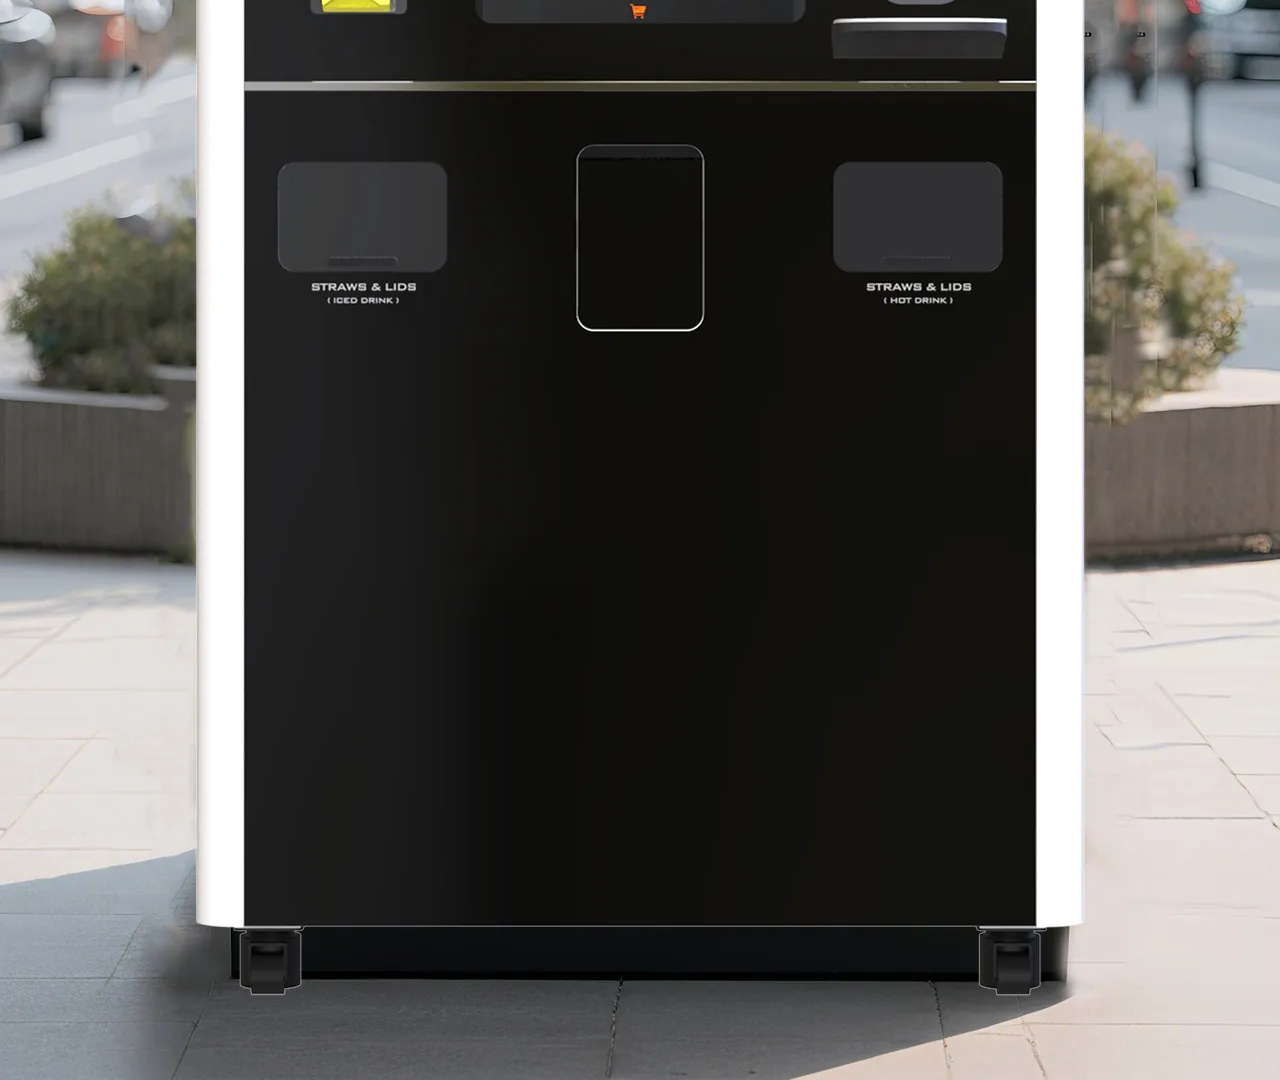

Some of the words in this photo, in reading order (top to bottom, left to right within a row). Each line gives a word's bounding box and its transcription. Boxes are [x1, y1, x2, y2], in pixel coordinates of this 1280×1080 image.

[311, 282, 367, 292] STRAWS
[371, 282, 381, 292] &
[385, 282, 417, 292] LIDS
[866, 282, 922, 292] STRAWS
[926, 282, 936, 292] &
[940, 282, 972, 292] LIDS
